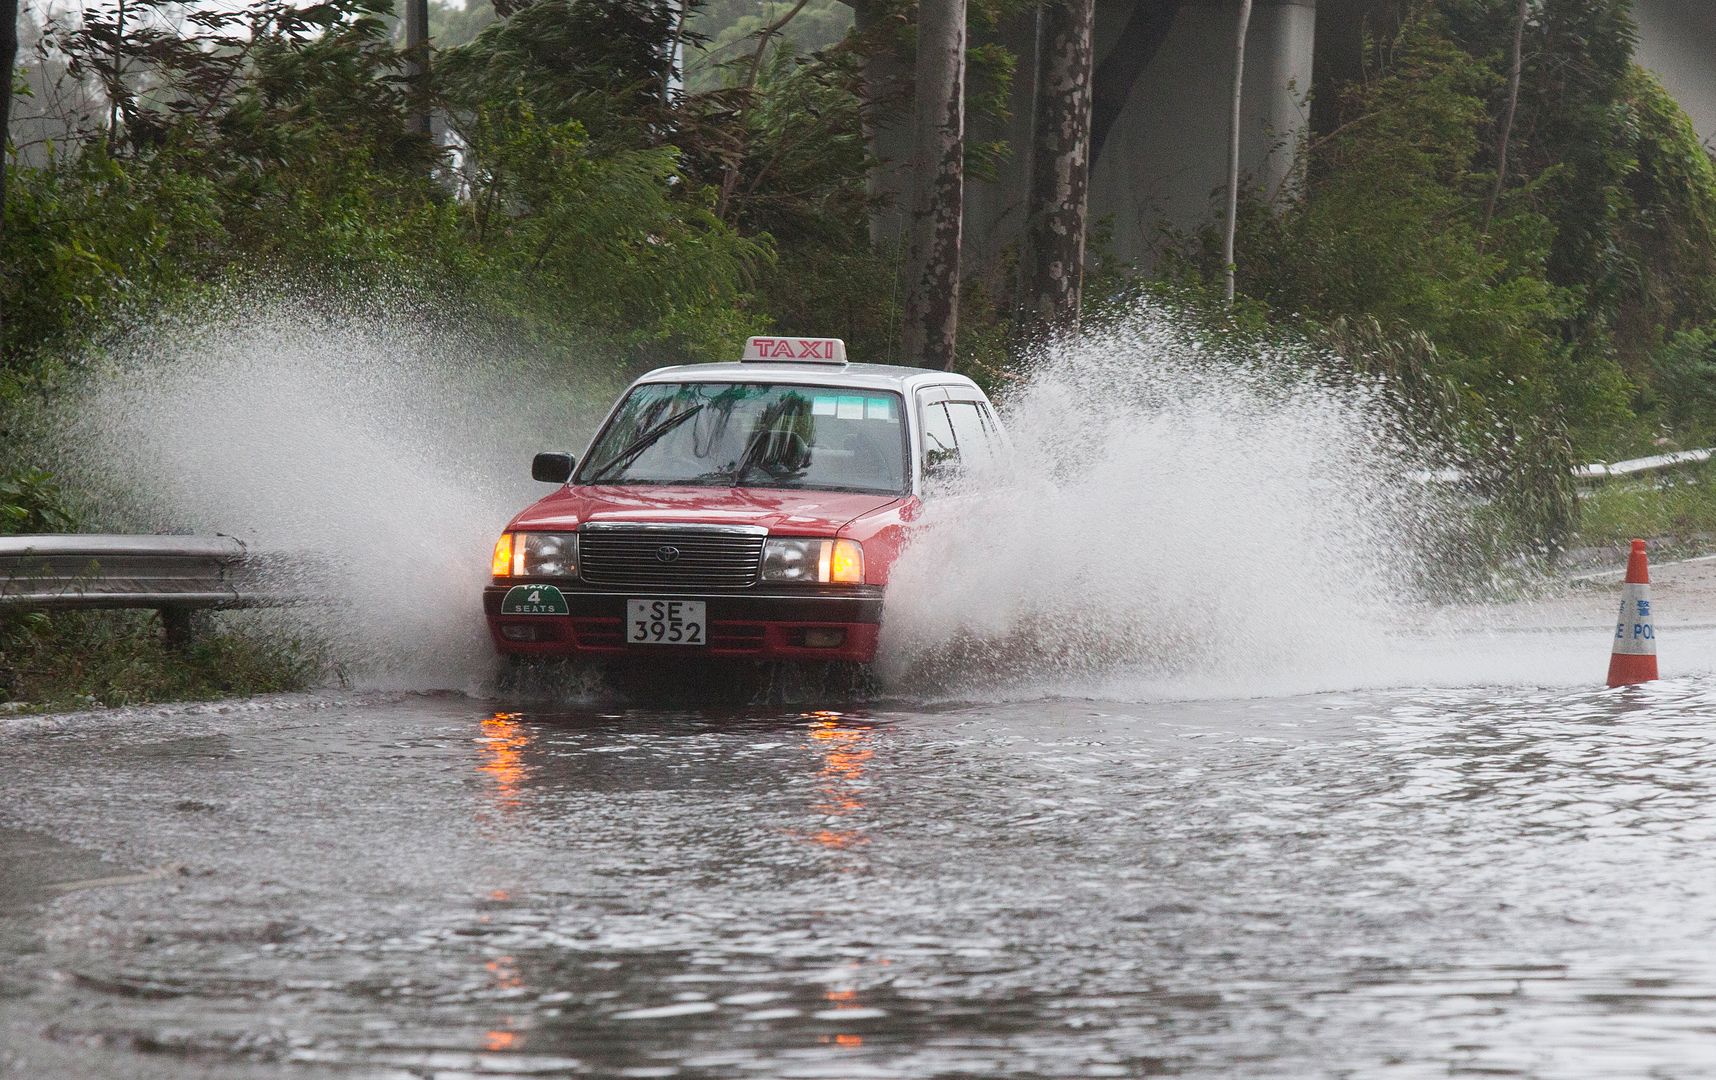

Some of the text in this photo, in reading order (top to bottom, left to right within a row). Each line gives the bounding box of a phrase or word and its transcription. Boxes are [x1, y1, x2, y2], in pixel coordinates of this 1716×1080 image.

[752, 340, 833, 359] TAXI
[527, 590, 541, 605] 4
[515, 604, 555, 613] SEATS
[650, 601, 683, 622] SE
[633, 621, 702, 643] 3952
